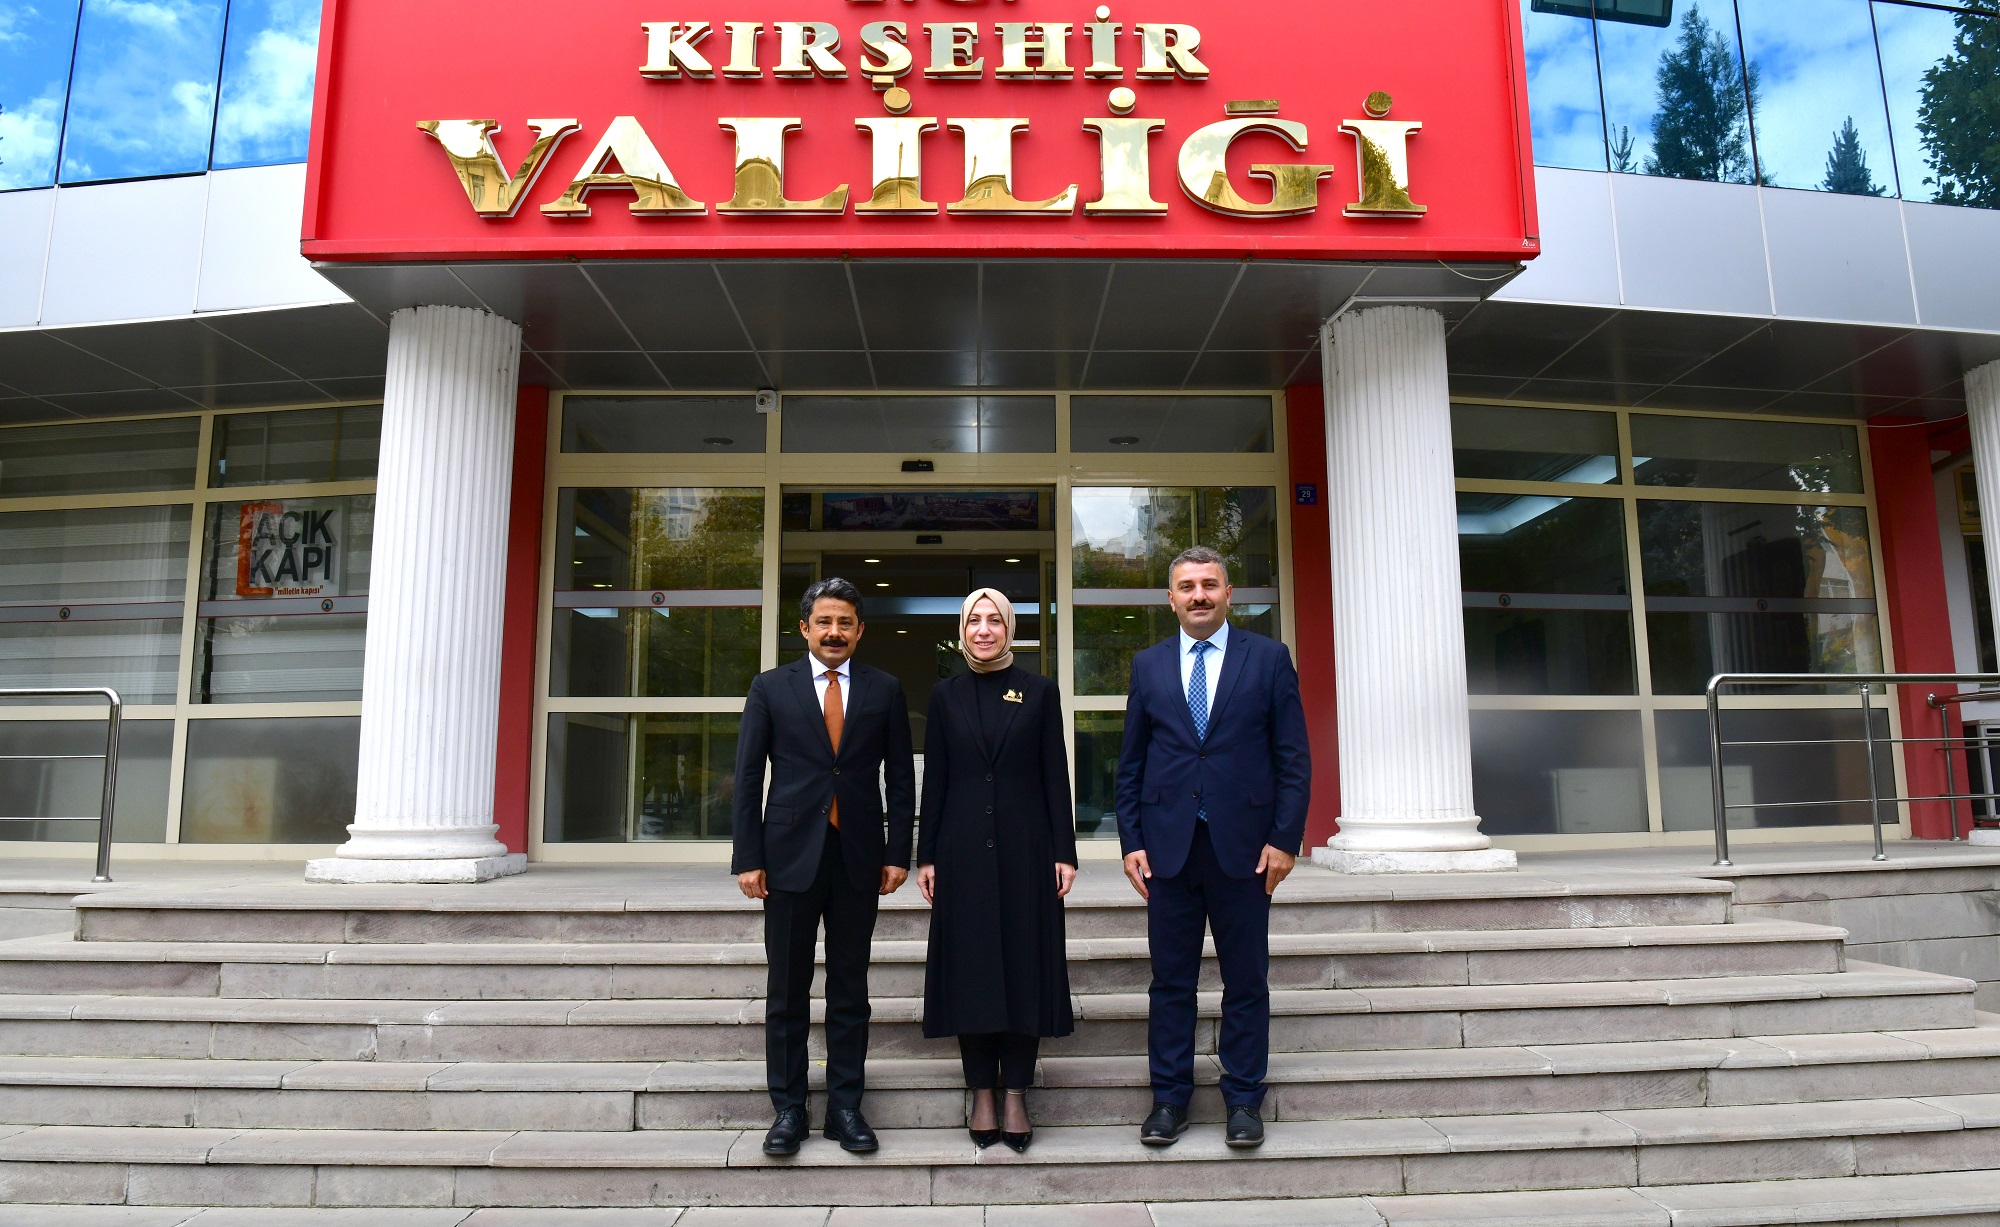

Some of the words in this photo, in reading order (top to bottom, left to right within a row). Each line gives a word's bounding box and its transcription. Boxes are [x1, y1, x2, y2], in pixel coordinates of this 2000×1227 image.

[640, 5, 1210, 91] KIRŞEHİR
[416, 86, 1428, 219] VALİLİĞİ
[1301, 490, 1311, 498] 29
[252, 510, 334, 547] AÇIK
[250, 546, 332, 583] KAPI
